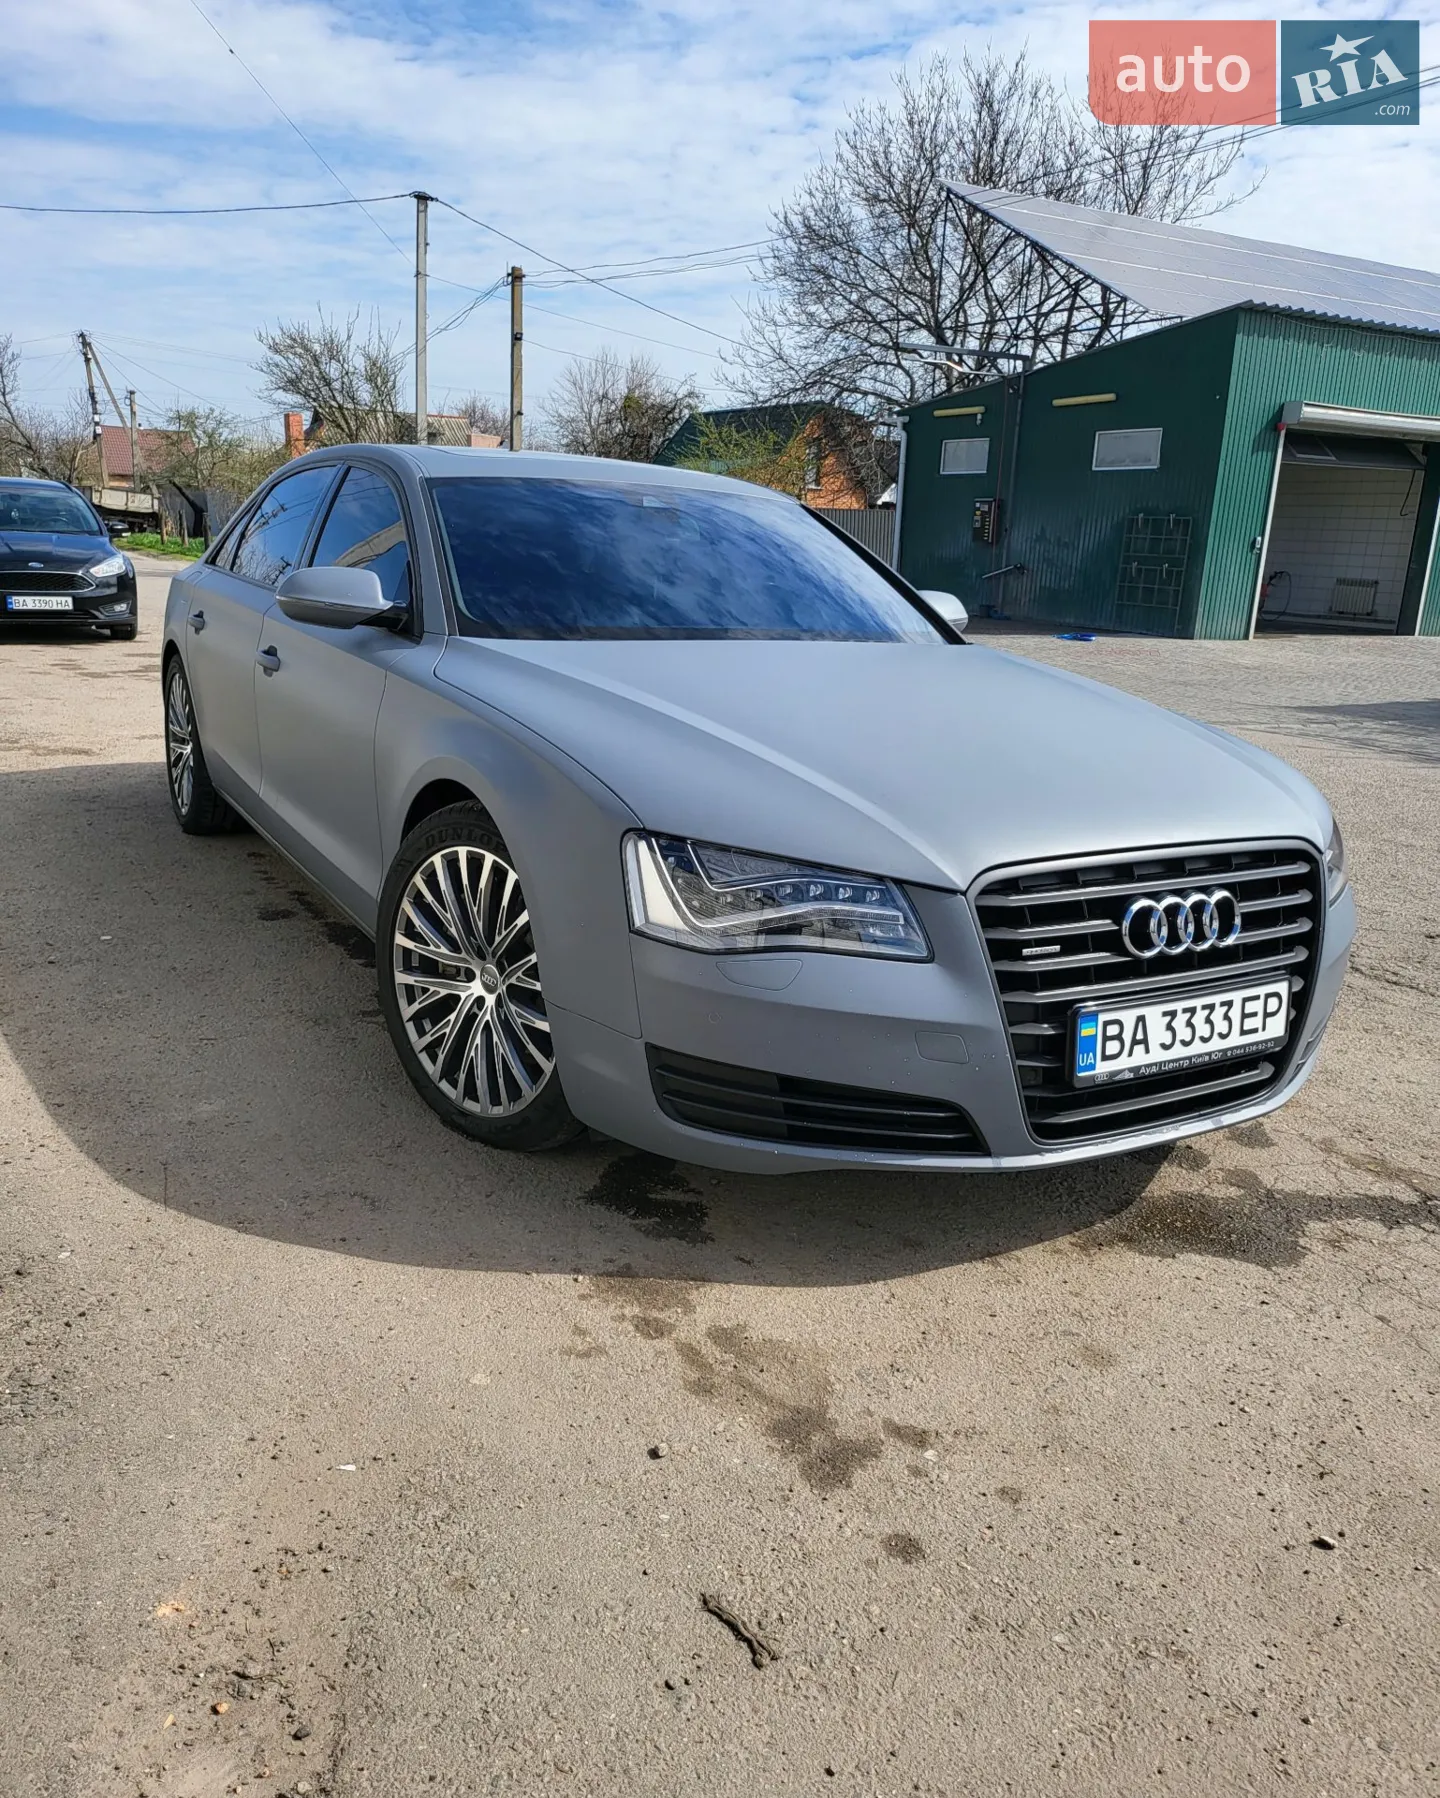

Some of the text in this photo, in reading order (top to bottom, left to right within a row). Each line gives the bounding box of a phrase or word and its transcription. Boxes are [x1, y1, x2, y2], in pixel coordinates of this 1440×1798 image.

[14, 598, 70, 609] BA 3390 HA
[1100, 991, 1283, 1062] BA 3333 EP
[1079, 1053, 1095, 1067] UA
[1161, 1060, 1190, 1071] Центр
